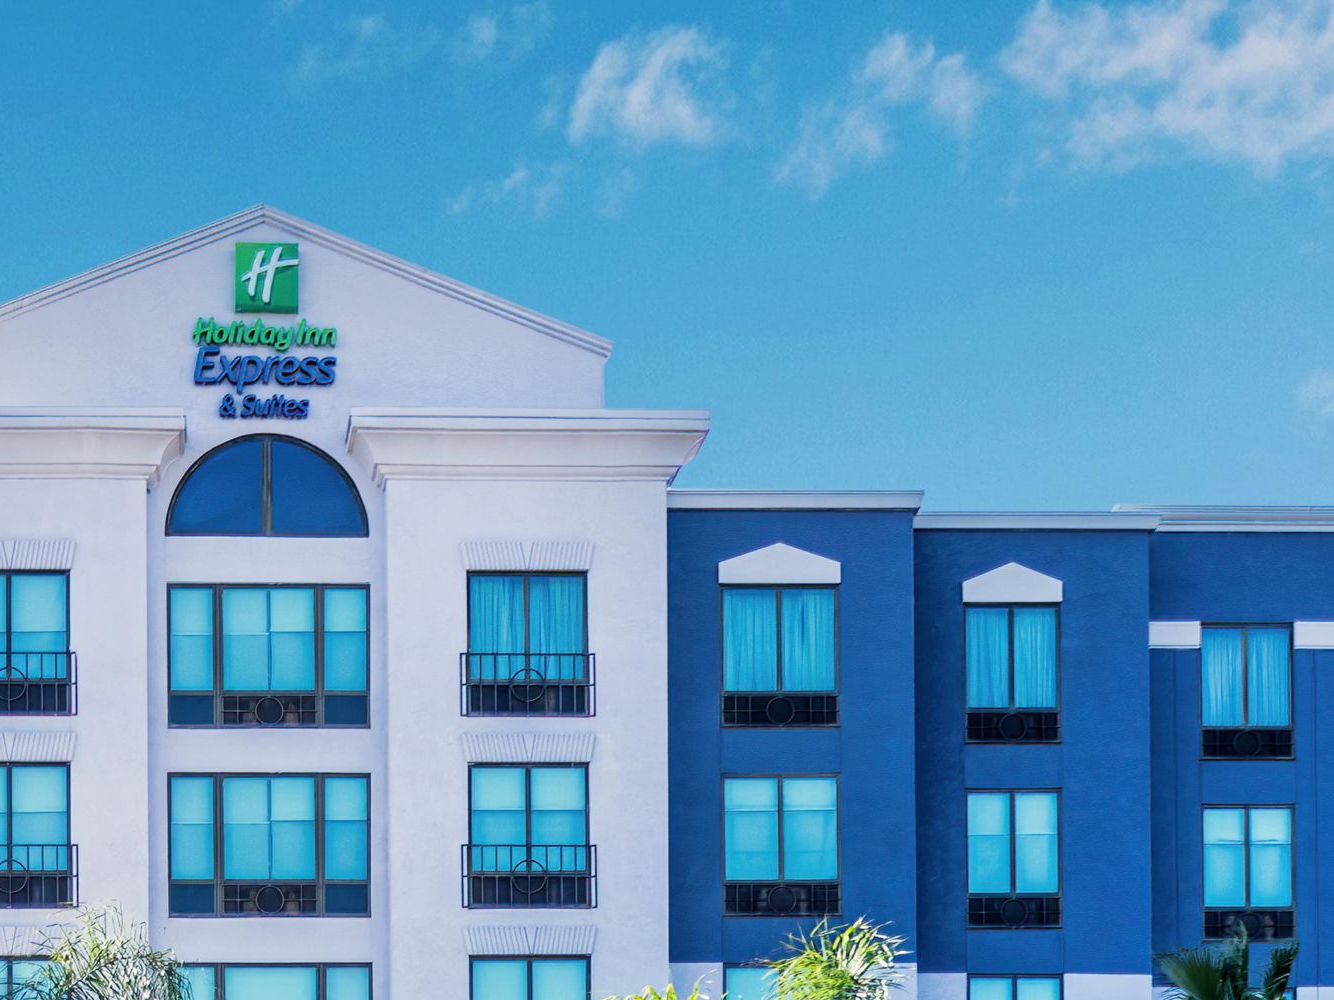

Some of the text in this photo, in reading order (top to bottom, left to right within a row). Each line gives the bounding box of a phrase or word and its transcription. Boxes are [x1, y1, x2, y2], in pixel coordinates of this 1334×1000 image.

[193, 317, 337, 352] Holiday Inn
[194, 346, 337, 395] Express
[219, 394, 310, 419] & Suites
